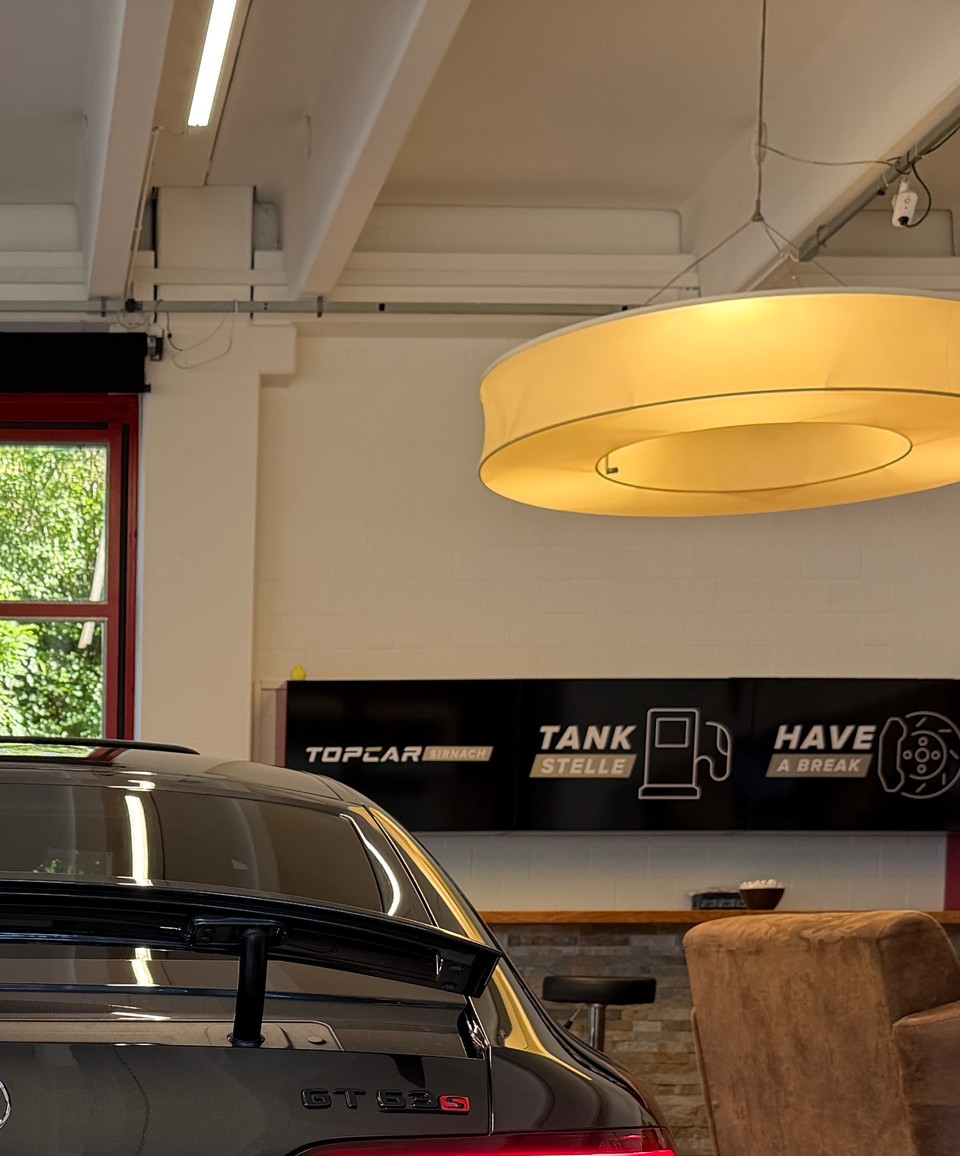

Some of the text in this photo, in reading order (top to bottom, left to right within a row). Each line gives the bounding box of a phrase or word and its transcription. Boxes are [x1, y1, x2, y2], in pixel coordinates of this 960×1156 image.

[539, 725, 637, 750] TANK
[773, 724, 877, 750] HAVE
[305, 746, 487, 763] TOPCAR SIRNACH
[540, 758, 626, 774] STELLE
[776, 758, 862, 772] A BREAK
[300, 1087, 367, 1109] GT
